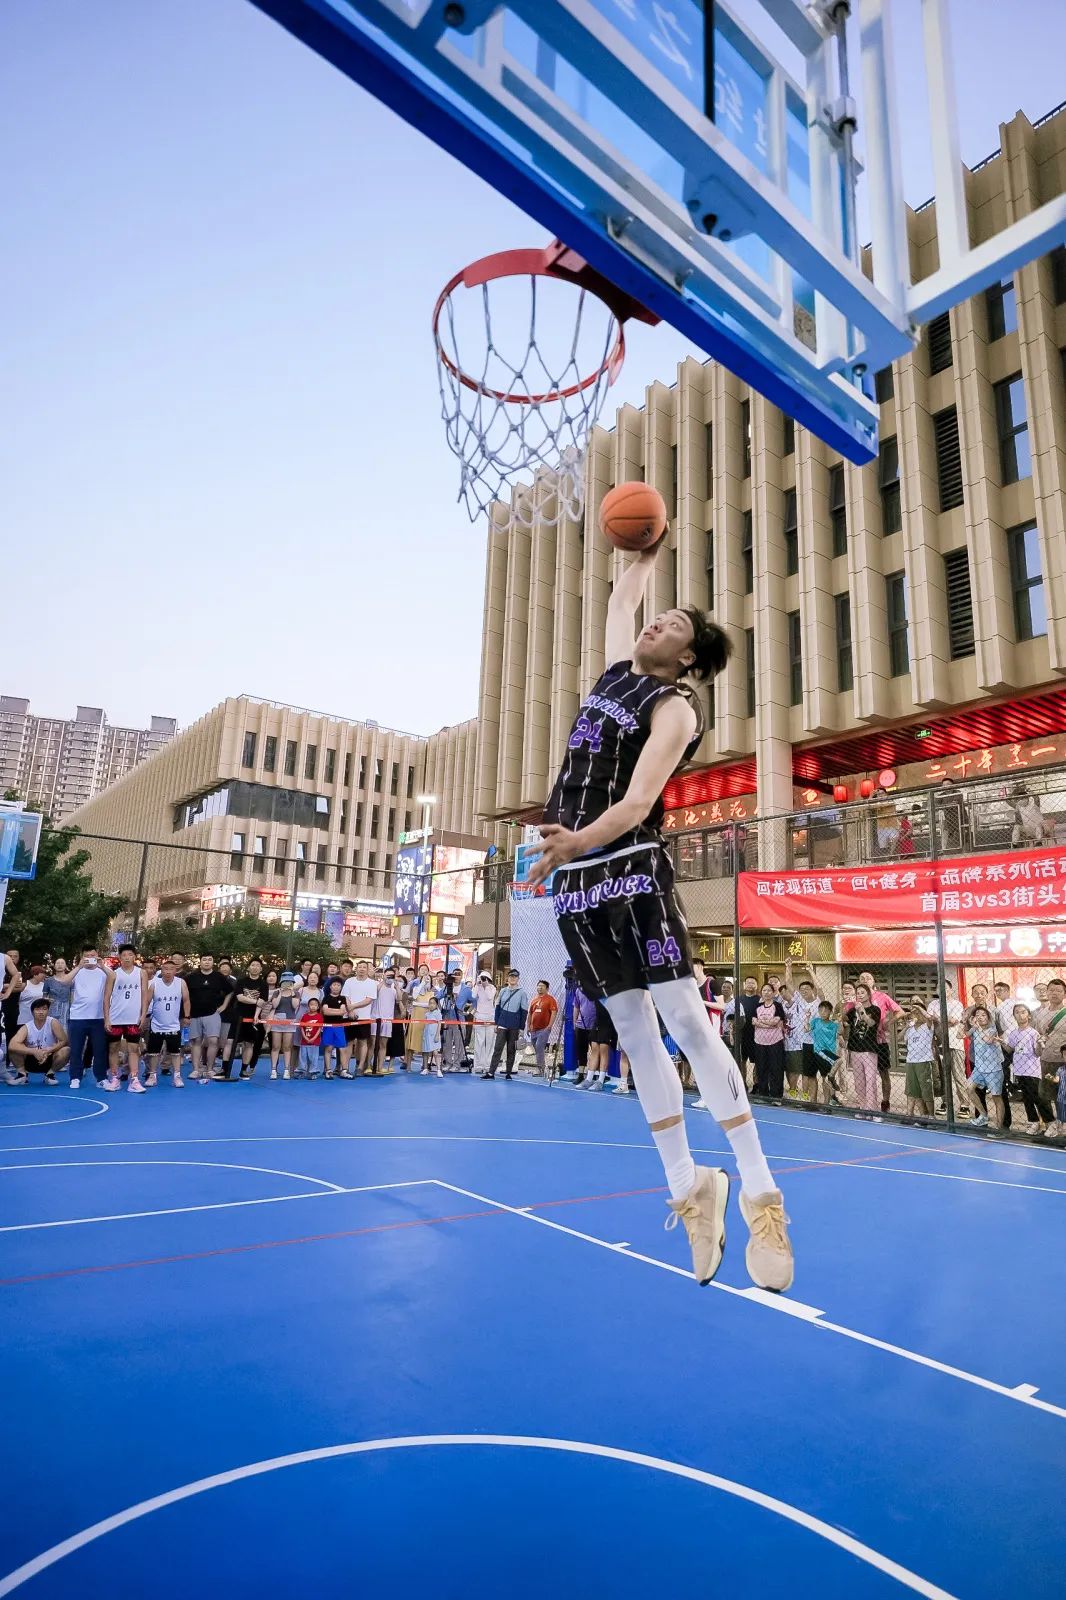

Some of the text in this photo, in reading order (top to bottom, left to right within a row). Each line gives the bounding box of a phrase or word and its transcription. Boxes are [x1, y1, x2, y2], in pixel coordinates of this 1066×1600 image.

[569, 716, 603, 753] 24
[926, 743, 1066, 778] 二十年烹一
[919, 883, 1066, 913] 首届3vs3街头
[646, 936, 682, 966] 24
[125, 990, 131, 1000] 6
[165, 1003, 171, 1011] 0
